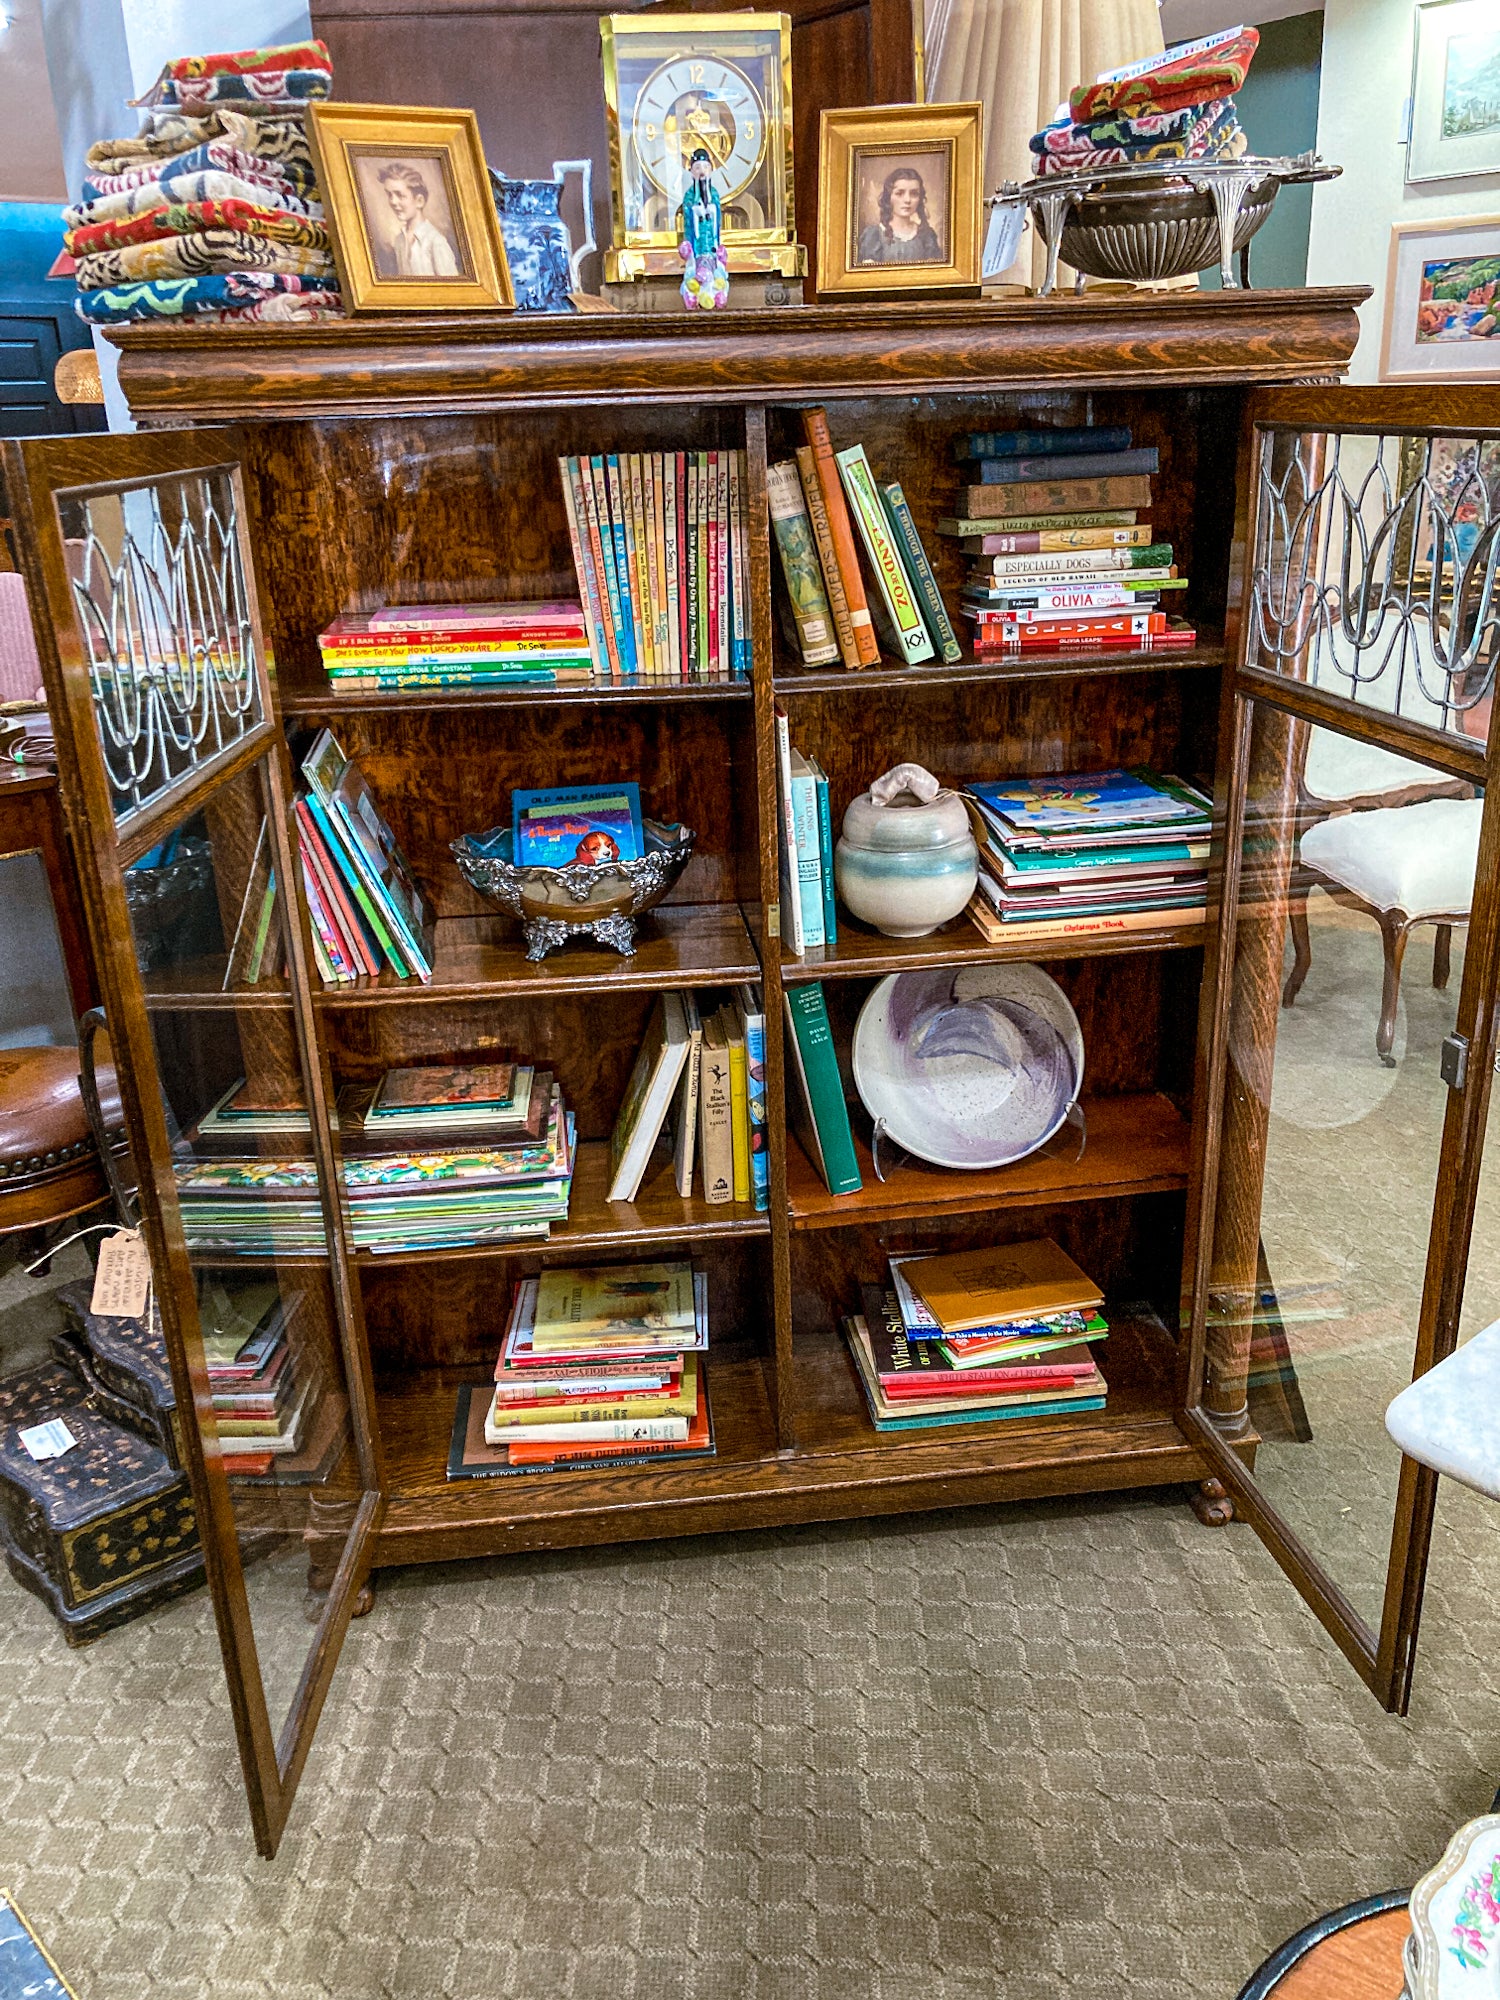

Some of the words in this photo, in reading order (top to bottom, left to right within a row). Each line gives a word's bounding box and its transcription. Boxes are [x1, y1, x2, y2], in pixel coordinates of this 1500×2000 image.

[690, 64, 704, 84] 12
[645, 124, 656, 142] 9
[744, 121, 755, 141] 3
[806, 472, 831, 542] TRAVELS
[689, 531, 697, 546] Ten
[709, 530, 717, 557] Robert
[594, 536, 603, 563] LITTLE
[617, 541, 625, 555] FLY
[870, 526, 896, 573] LAND
[688, 548, 697, 576] Apples
[1005, 559, 1063, 573] ESPECIALLY
[1066, 558, 1092, 569] DOGS
[620, 559, 629, 585] WENT
[709, 571, 717, 589] Rose
[890, 573, 901, 586] OF
[899, 511, 921, 558] THROUGH
[914, 557, 929, 578] THE
[922, 581, 942, 613] GREEN
[936, 614, 951, 640] GATE
[689, 577, 697, 588] Up
[623, 586, 630, 598] BY
[689, 588, 697, 600] On
[709, 590, 717, 611] Horse
[823, 550, 854, 647] GULLIVER'S
[894, 585, 909, 609] OZ
[1052, 594, 1093, 608] OLIVIA
[591, 597, 603, 624] HOUSE
[1026, 622, 1124, 635] OLIVIA
[357, 637, 374, 645] RAN
[373, 648, 387, 656] Tell
[389, 646, 405, 656] You
[431, 642, 458, 653] LUCKY
[362, 668, 376, 676] THE
[378, 667, 407, 675] GRINCH
[409, 665, 429, 673] STOLE
[432, 663, 473, 673] CHRISTMAS
[531, 796, 552, 804] OLD
[805, 786, 813, 803] THE
[806, 805, 815, 831] LONG
[798, 815, 806, 848] WINTER
[1063, 924, 1100, 934] Christmas
[1102, 921, 1127, 929] Book
[706, 1101, 730, 1109] Stallion's
[881, 1290, 904, 1333] Stallion
[891, 1335, 913, 1371] White
[920, 1357, 931, 1366] OF
[579, 1367, 607, 1376] HOLLY
[937, 1373, 967, 1381] WHITE
[967, 1370, 1009, 1380] STALLION
[1020, 1368, 1054, 1377] LIPIZZA
[526, 1466, 554, 1475] BROOM
[569, 1463, 592, 1471] CHRIS
